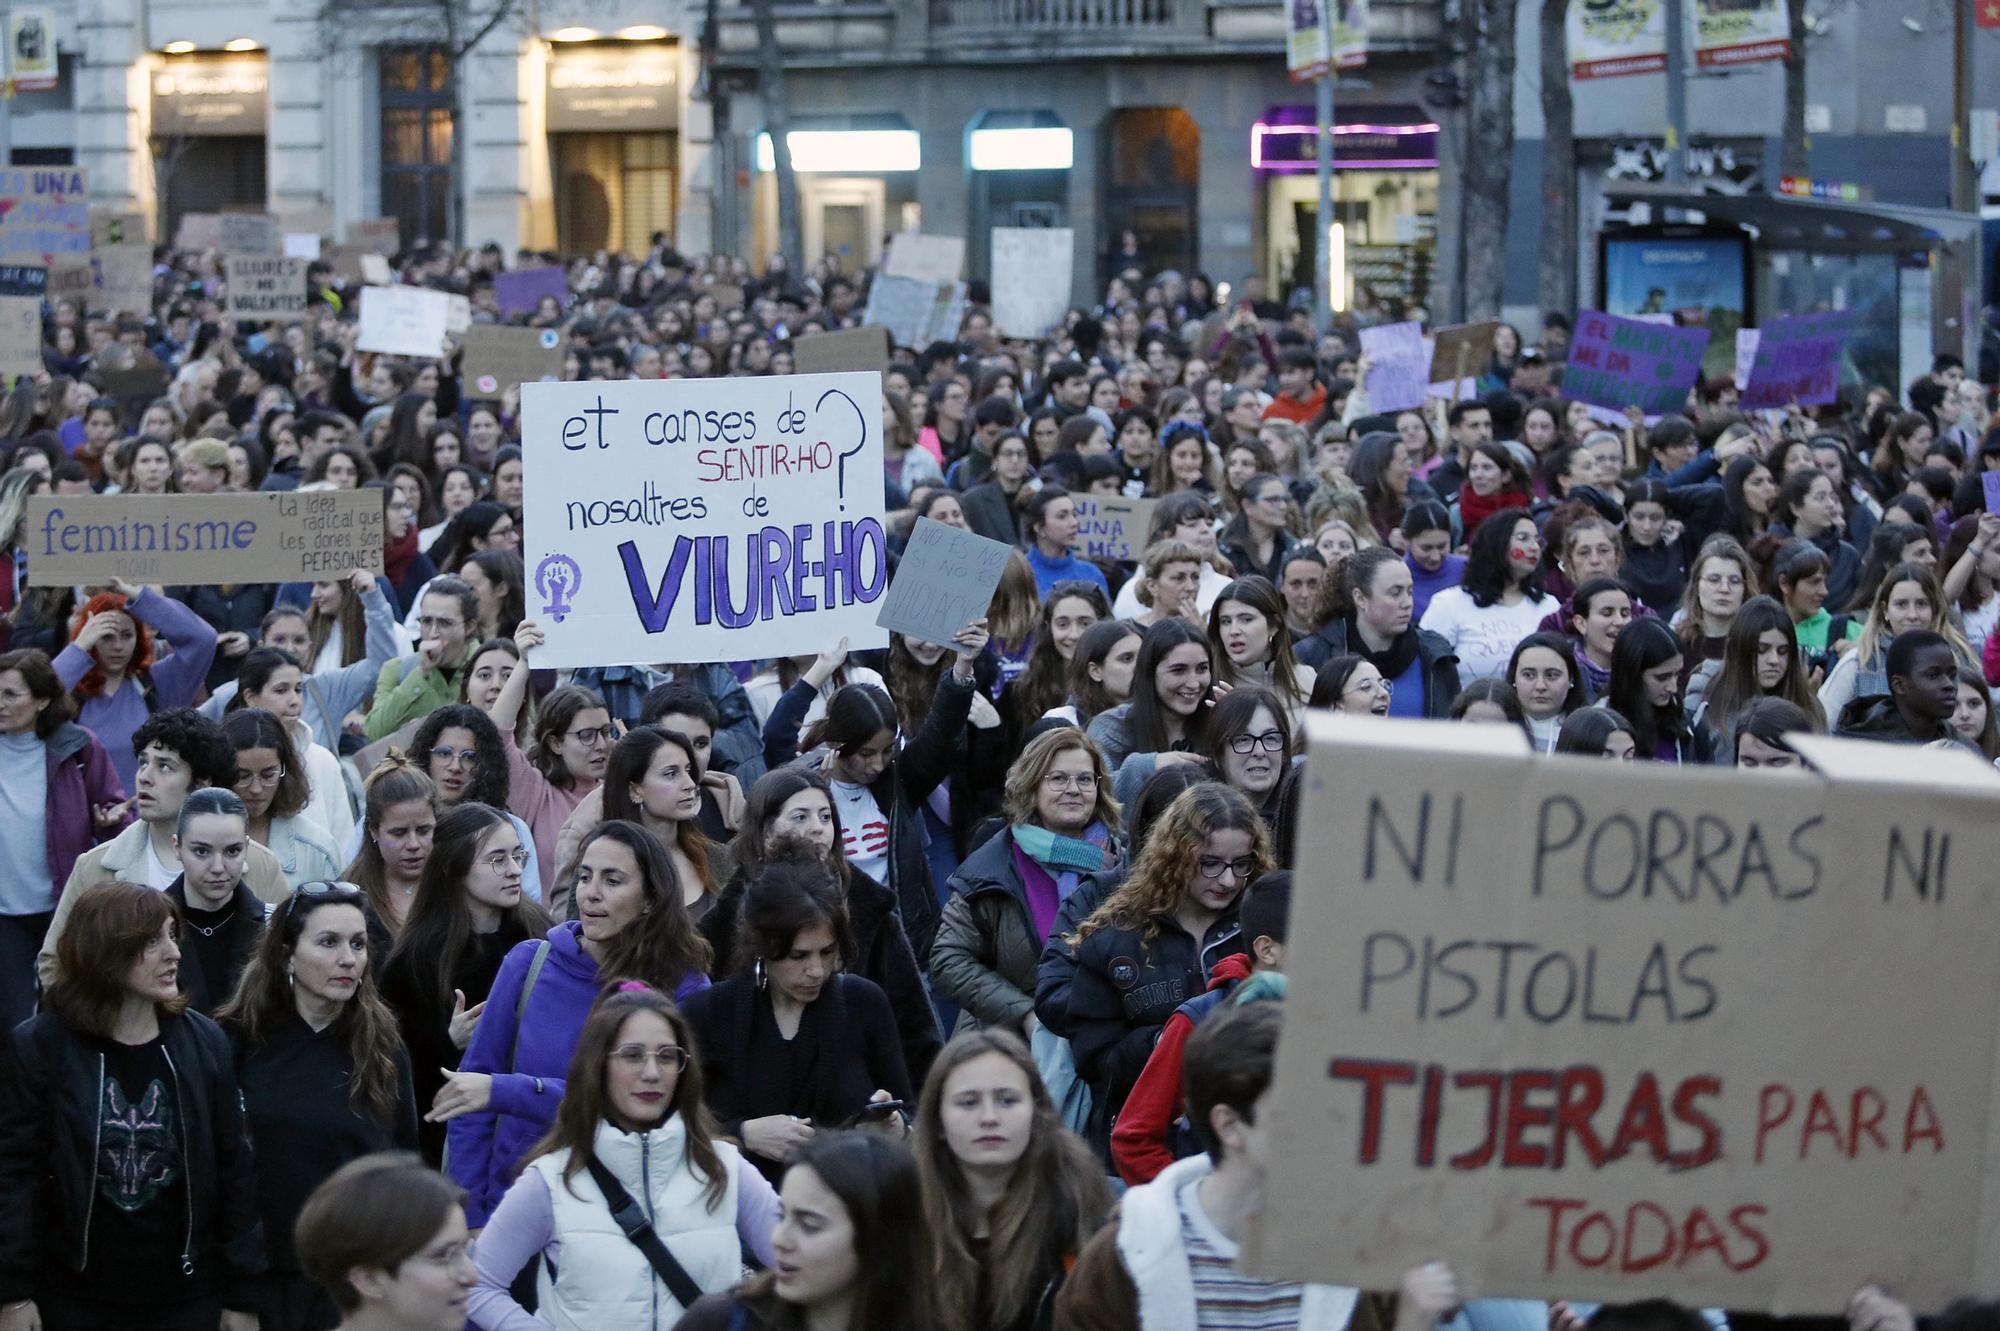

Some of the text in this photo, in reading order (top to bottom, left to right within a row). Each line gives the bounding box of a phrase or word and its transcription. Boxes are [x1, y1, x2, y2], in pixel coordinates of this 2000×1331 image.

[33, 171, 83, 195] UNA
[561, 390, 807, 451] et canses de
[697, 441, 833, 483] SENTIR-HO
[303, 509, 382, 531] radical que
[566, 480, 770, 531] nosaltres de
[1074, 501, 1096, 516] NI
[41, 508, 258, 556] feminisme
[314, 531, 352, 549] dones
[919, 527, 943, 545] NO
[977, 546, 1003, 569] NO
[1077, 520, 1123, 536] UNA
[1088, 536, 1130, 559] MÉS
[617, 516, 888, 635] VIURE-HO
[938, 560, 968, 579] NO
[1361, 791, 1952, 907] NI PORRAS NI
[1359, 929, 1721, 1027] PISTOLAS
[1327, 1055, 1948, 1175] TIJERAS PARA
[1525, 1197, 1773, 1276] TODAS
